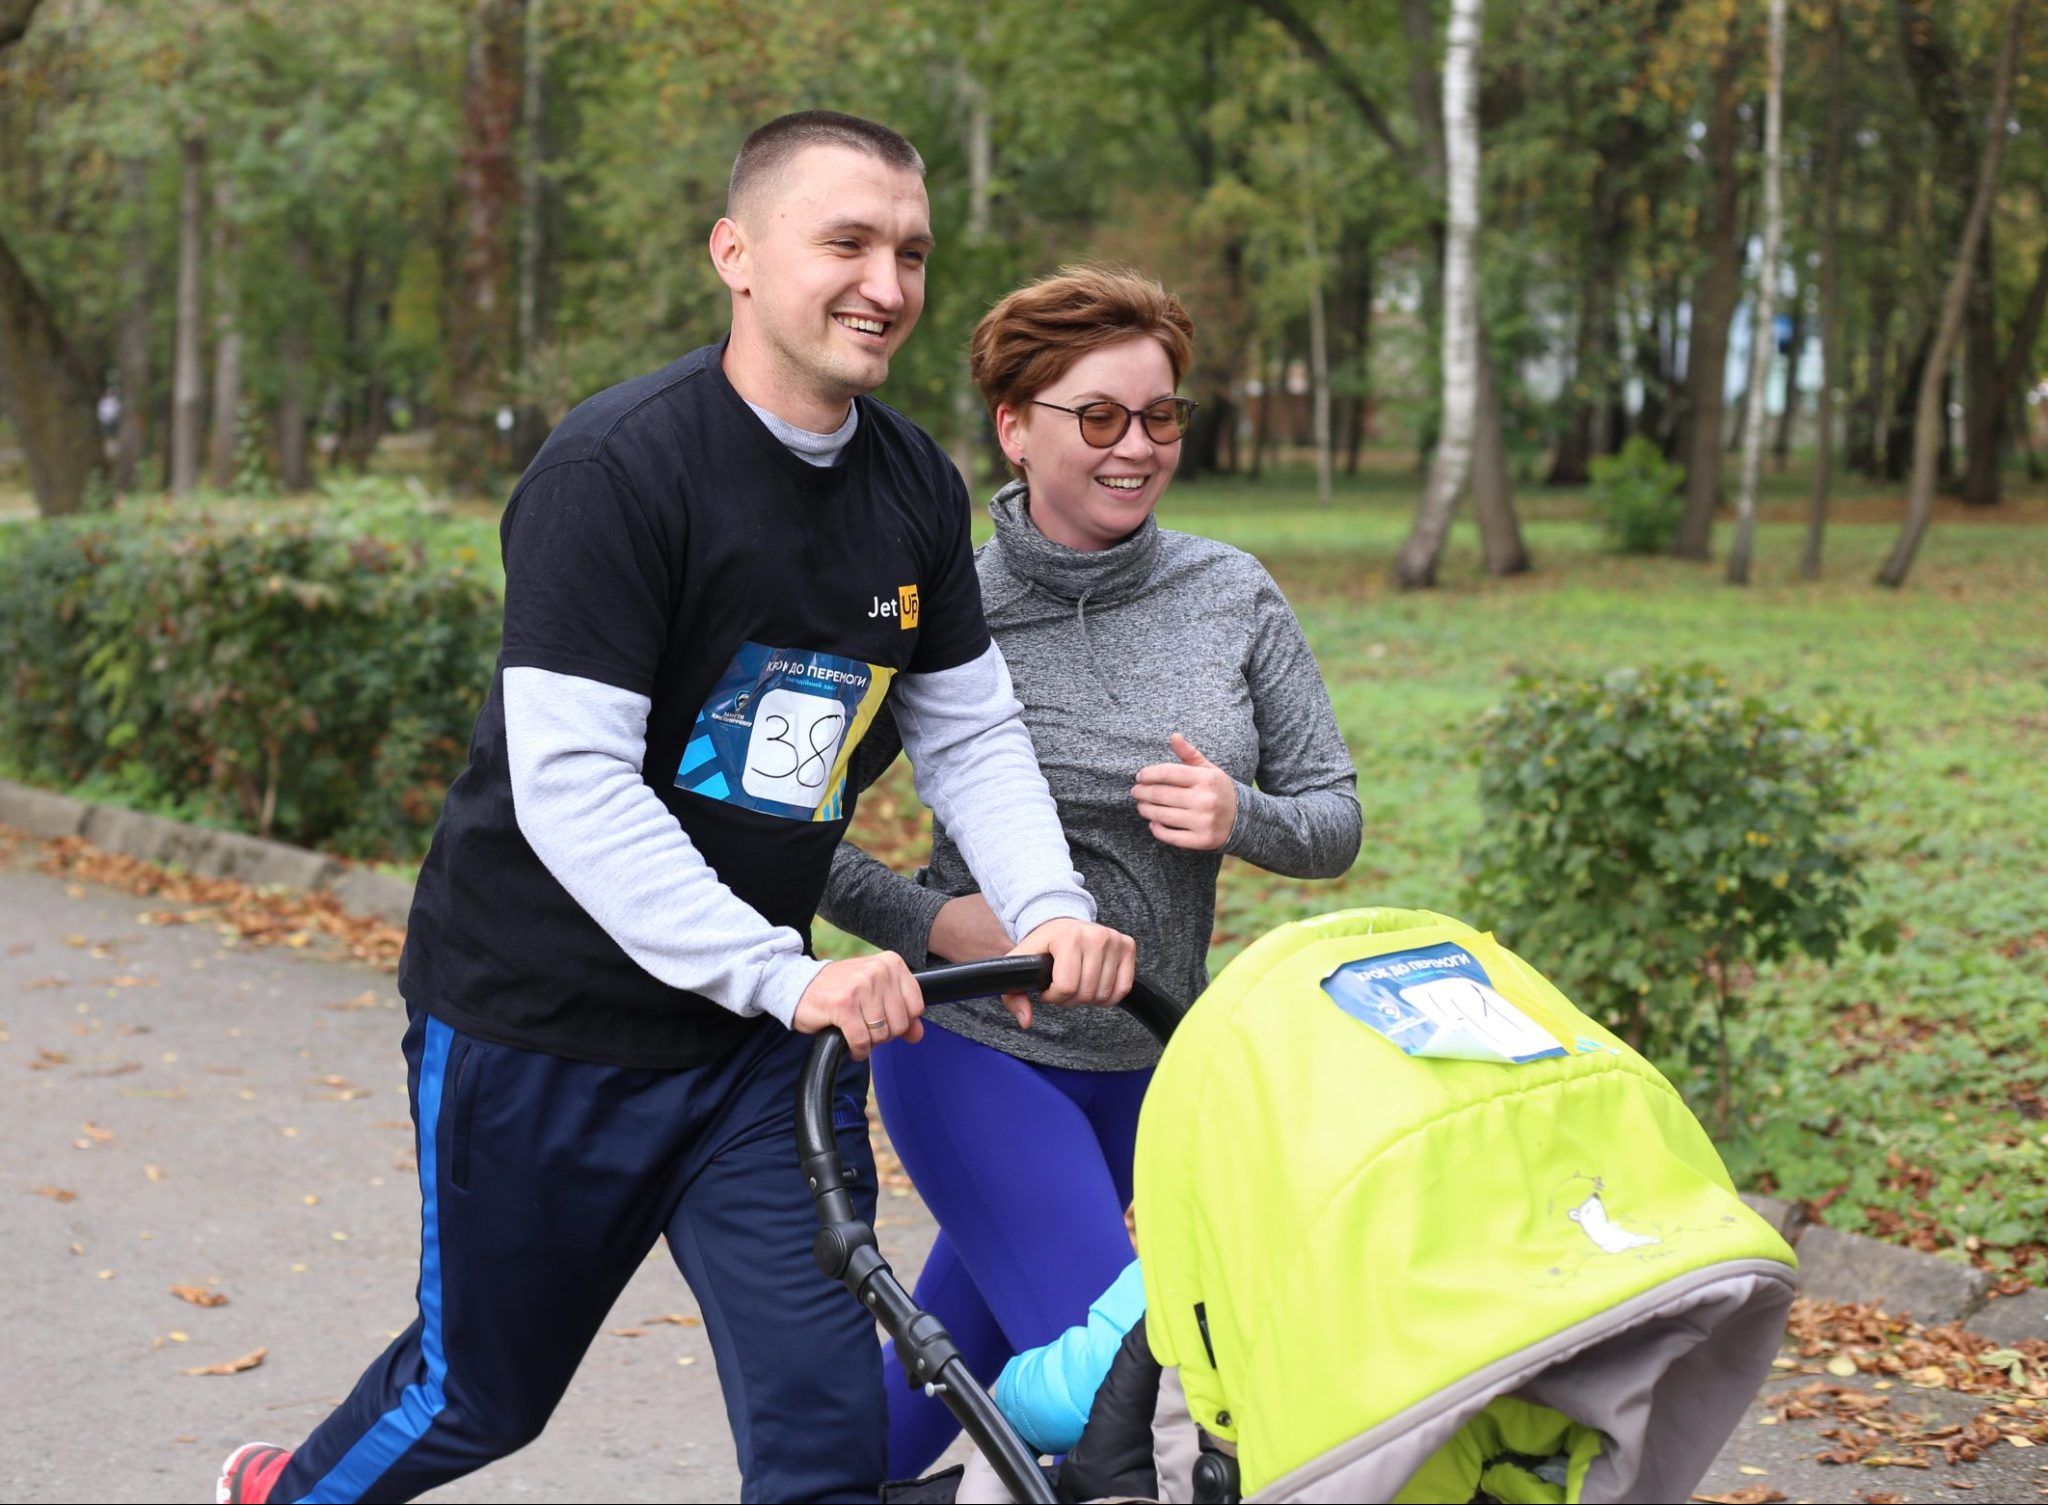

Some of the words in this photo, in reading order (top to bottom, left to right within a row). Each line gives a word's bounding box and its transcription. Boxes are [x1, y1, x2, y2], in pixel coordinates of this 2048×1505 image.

[788, 662, 805, 675] ДО
[807, 665, 868, 688] ПЕРЕМОГИ
[751, 714, 844, 788] 38
[1389, 962, 1411, 977] ДО
